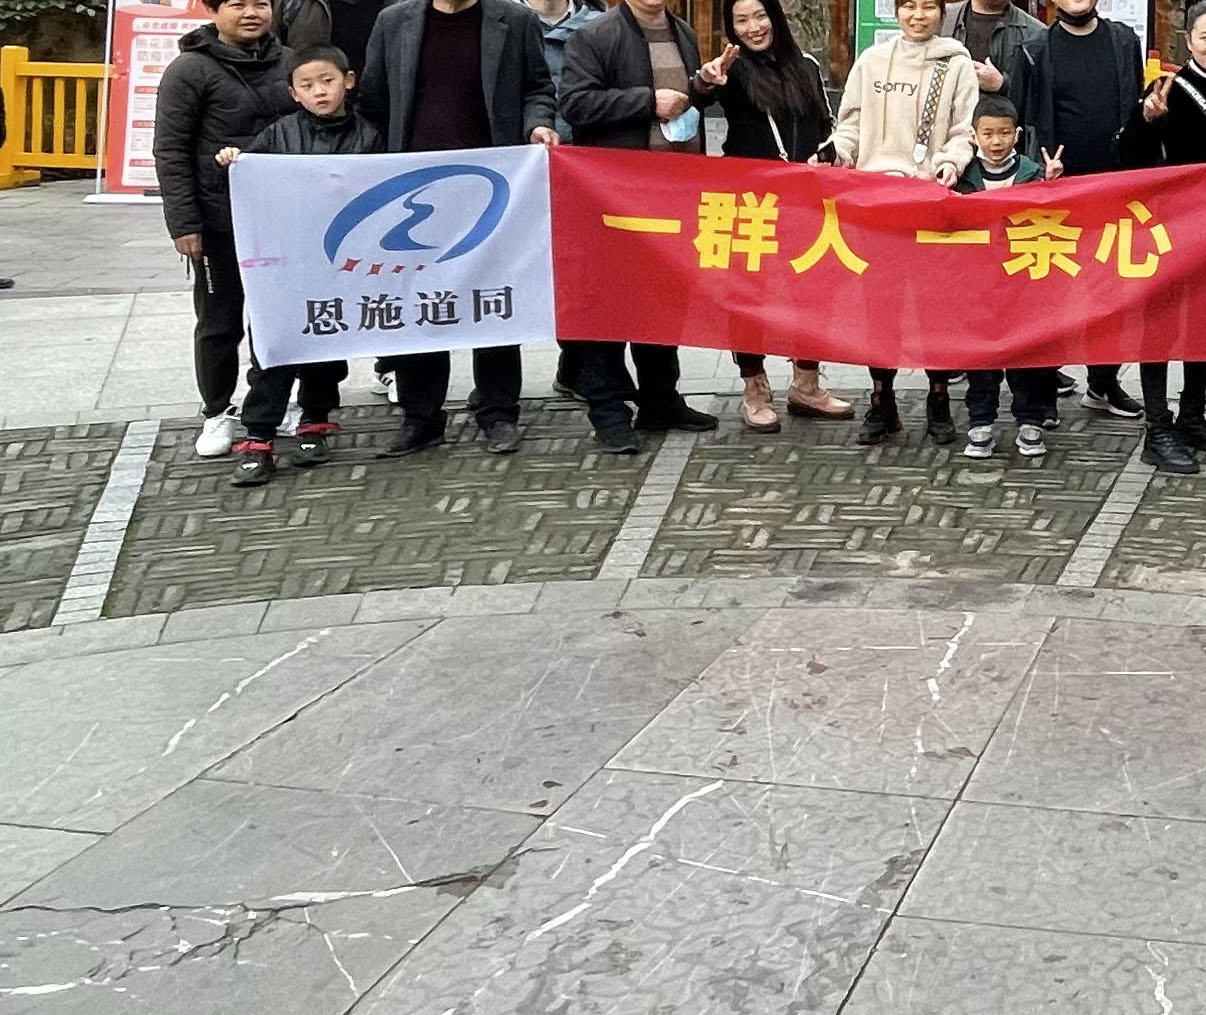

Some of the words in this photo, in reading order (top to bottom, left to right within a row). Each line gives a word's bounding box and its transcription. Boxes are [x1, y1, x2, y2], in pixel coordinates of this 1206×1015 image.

[602, 190, 869, 275] 一群人
[916, 201, 1172, 280] 一条心
[302, 285, 514, 336] 恩施道同
